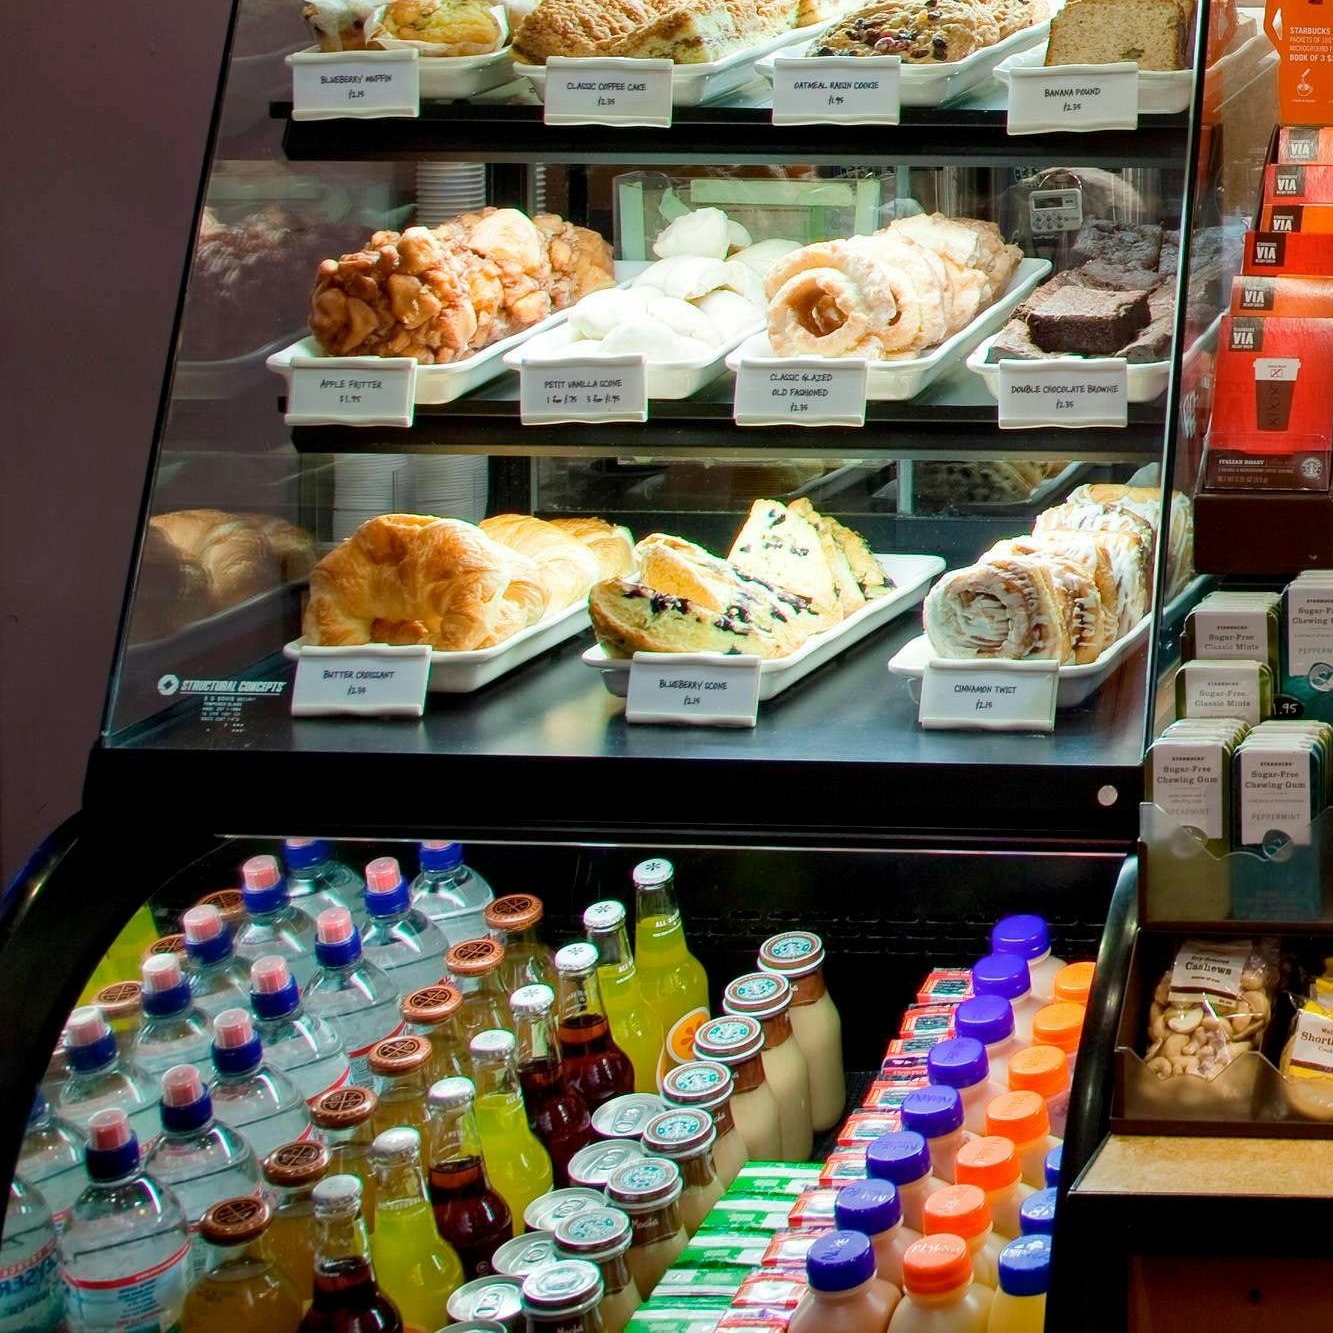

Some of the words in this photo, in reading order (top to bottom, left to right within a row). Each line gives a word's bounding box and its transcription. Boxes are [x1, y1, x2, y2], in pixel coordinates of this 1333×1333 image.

[1290, 26, 1331, 34] STARBUCKS
[1290, 54, 1308, 62] BOOK
[1311, 54, 1318, 62] OF
[1320, 54, 1325, 62] 3
[1256, 248, 1276, 260] VIA
[1293, 616, 1329, 626] Chewing
[181, 680, 237, 692] STRUCTURAL
[239, 681, 284, 692] CONCEPTS
[1185, 962, 1232, 976] Cashews
